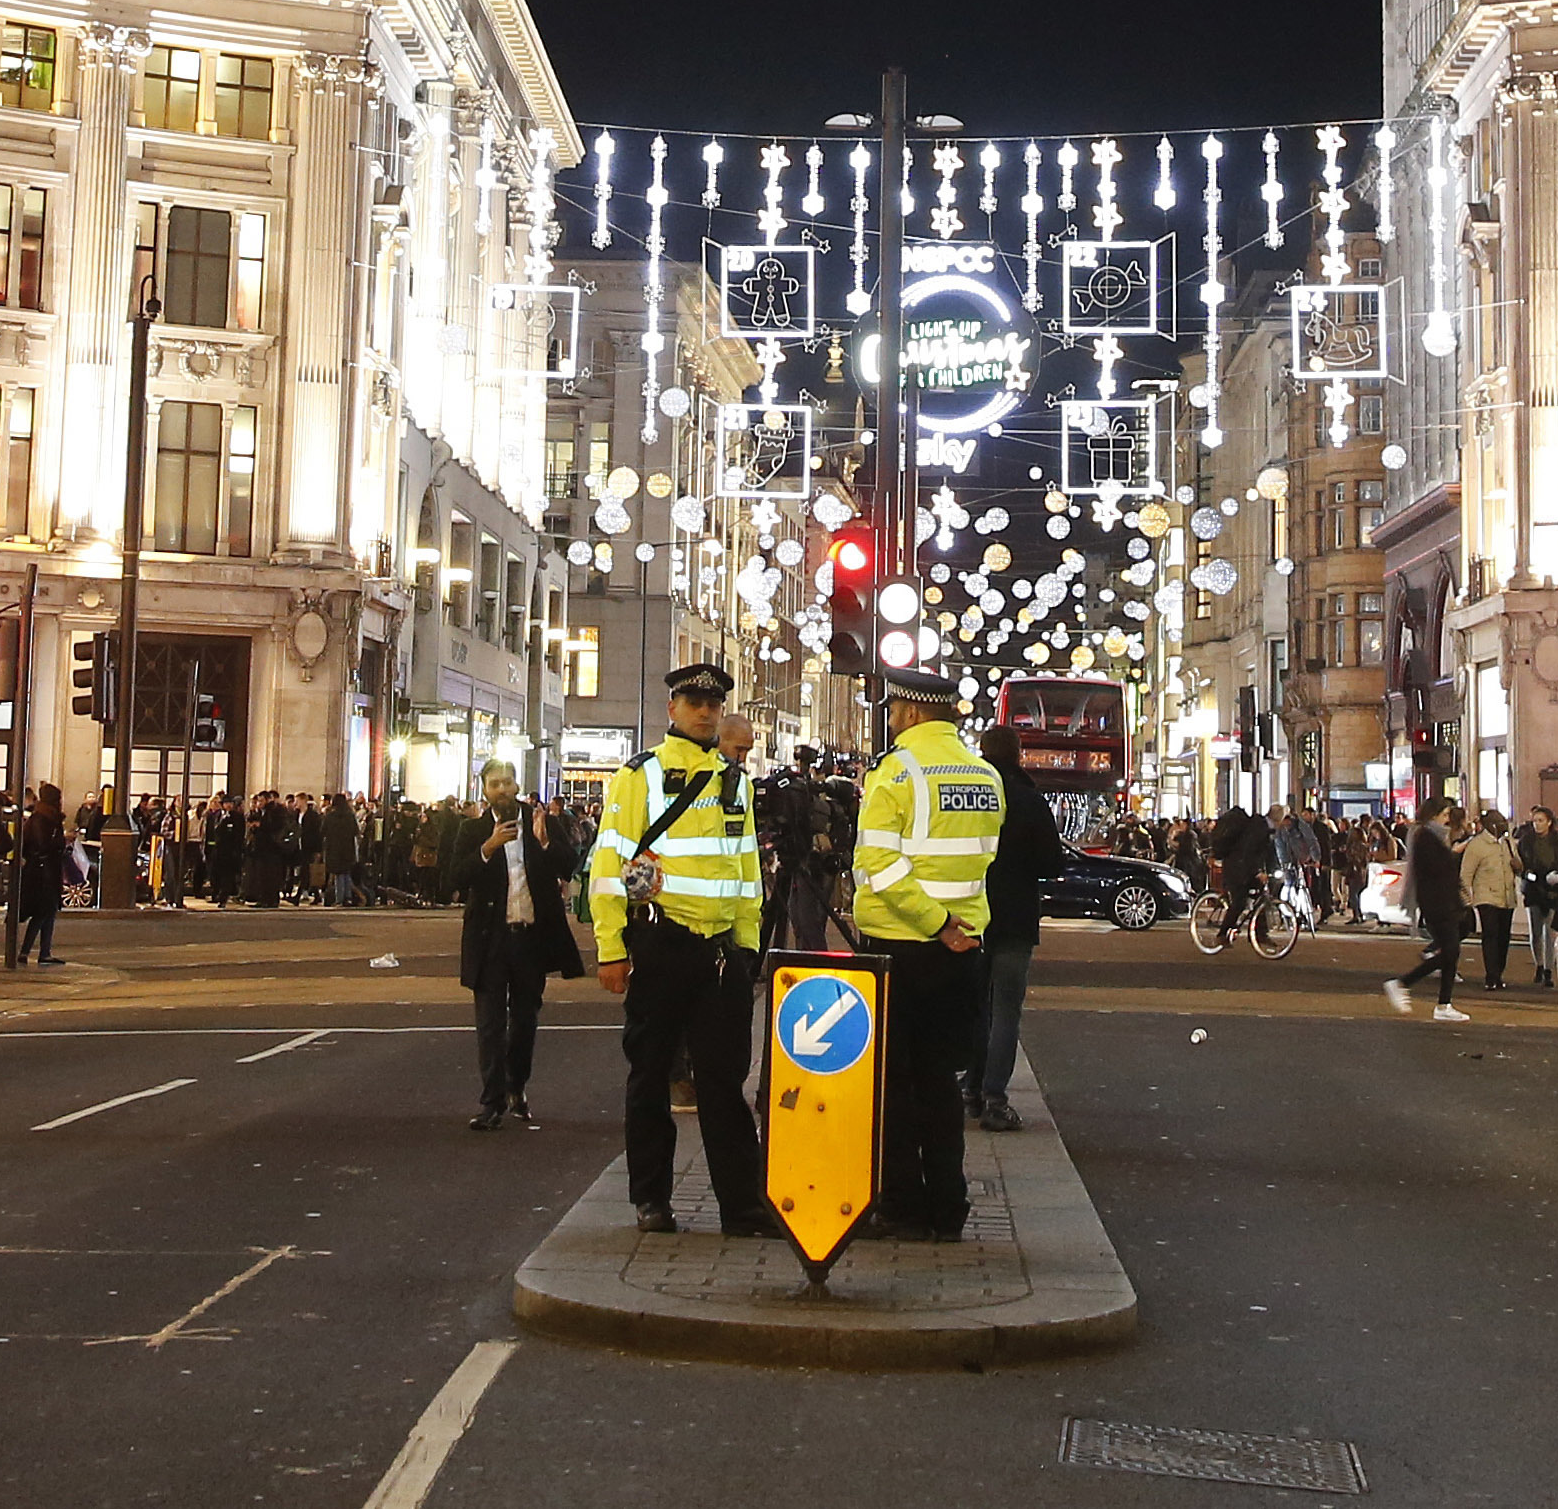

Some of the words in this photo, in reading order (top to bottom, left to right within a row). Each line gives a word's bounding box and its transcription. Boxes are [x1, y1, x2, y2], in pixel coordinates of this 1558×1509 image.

[910, 320, 957, 340] LIGHT
[959, 321, 982, 339] UP
[928, 362, 1004, 387] CHILDREN
[1089, 752, 1111, 768] 25
[941, 794, 998, 809] POLICE
